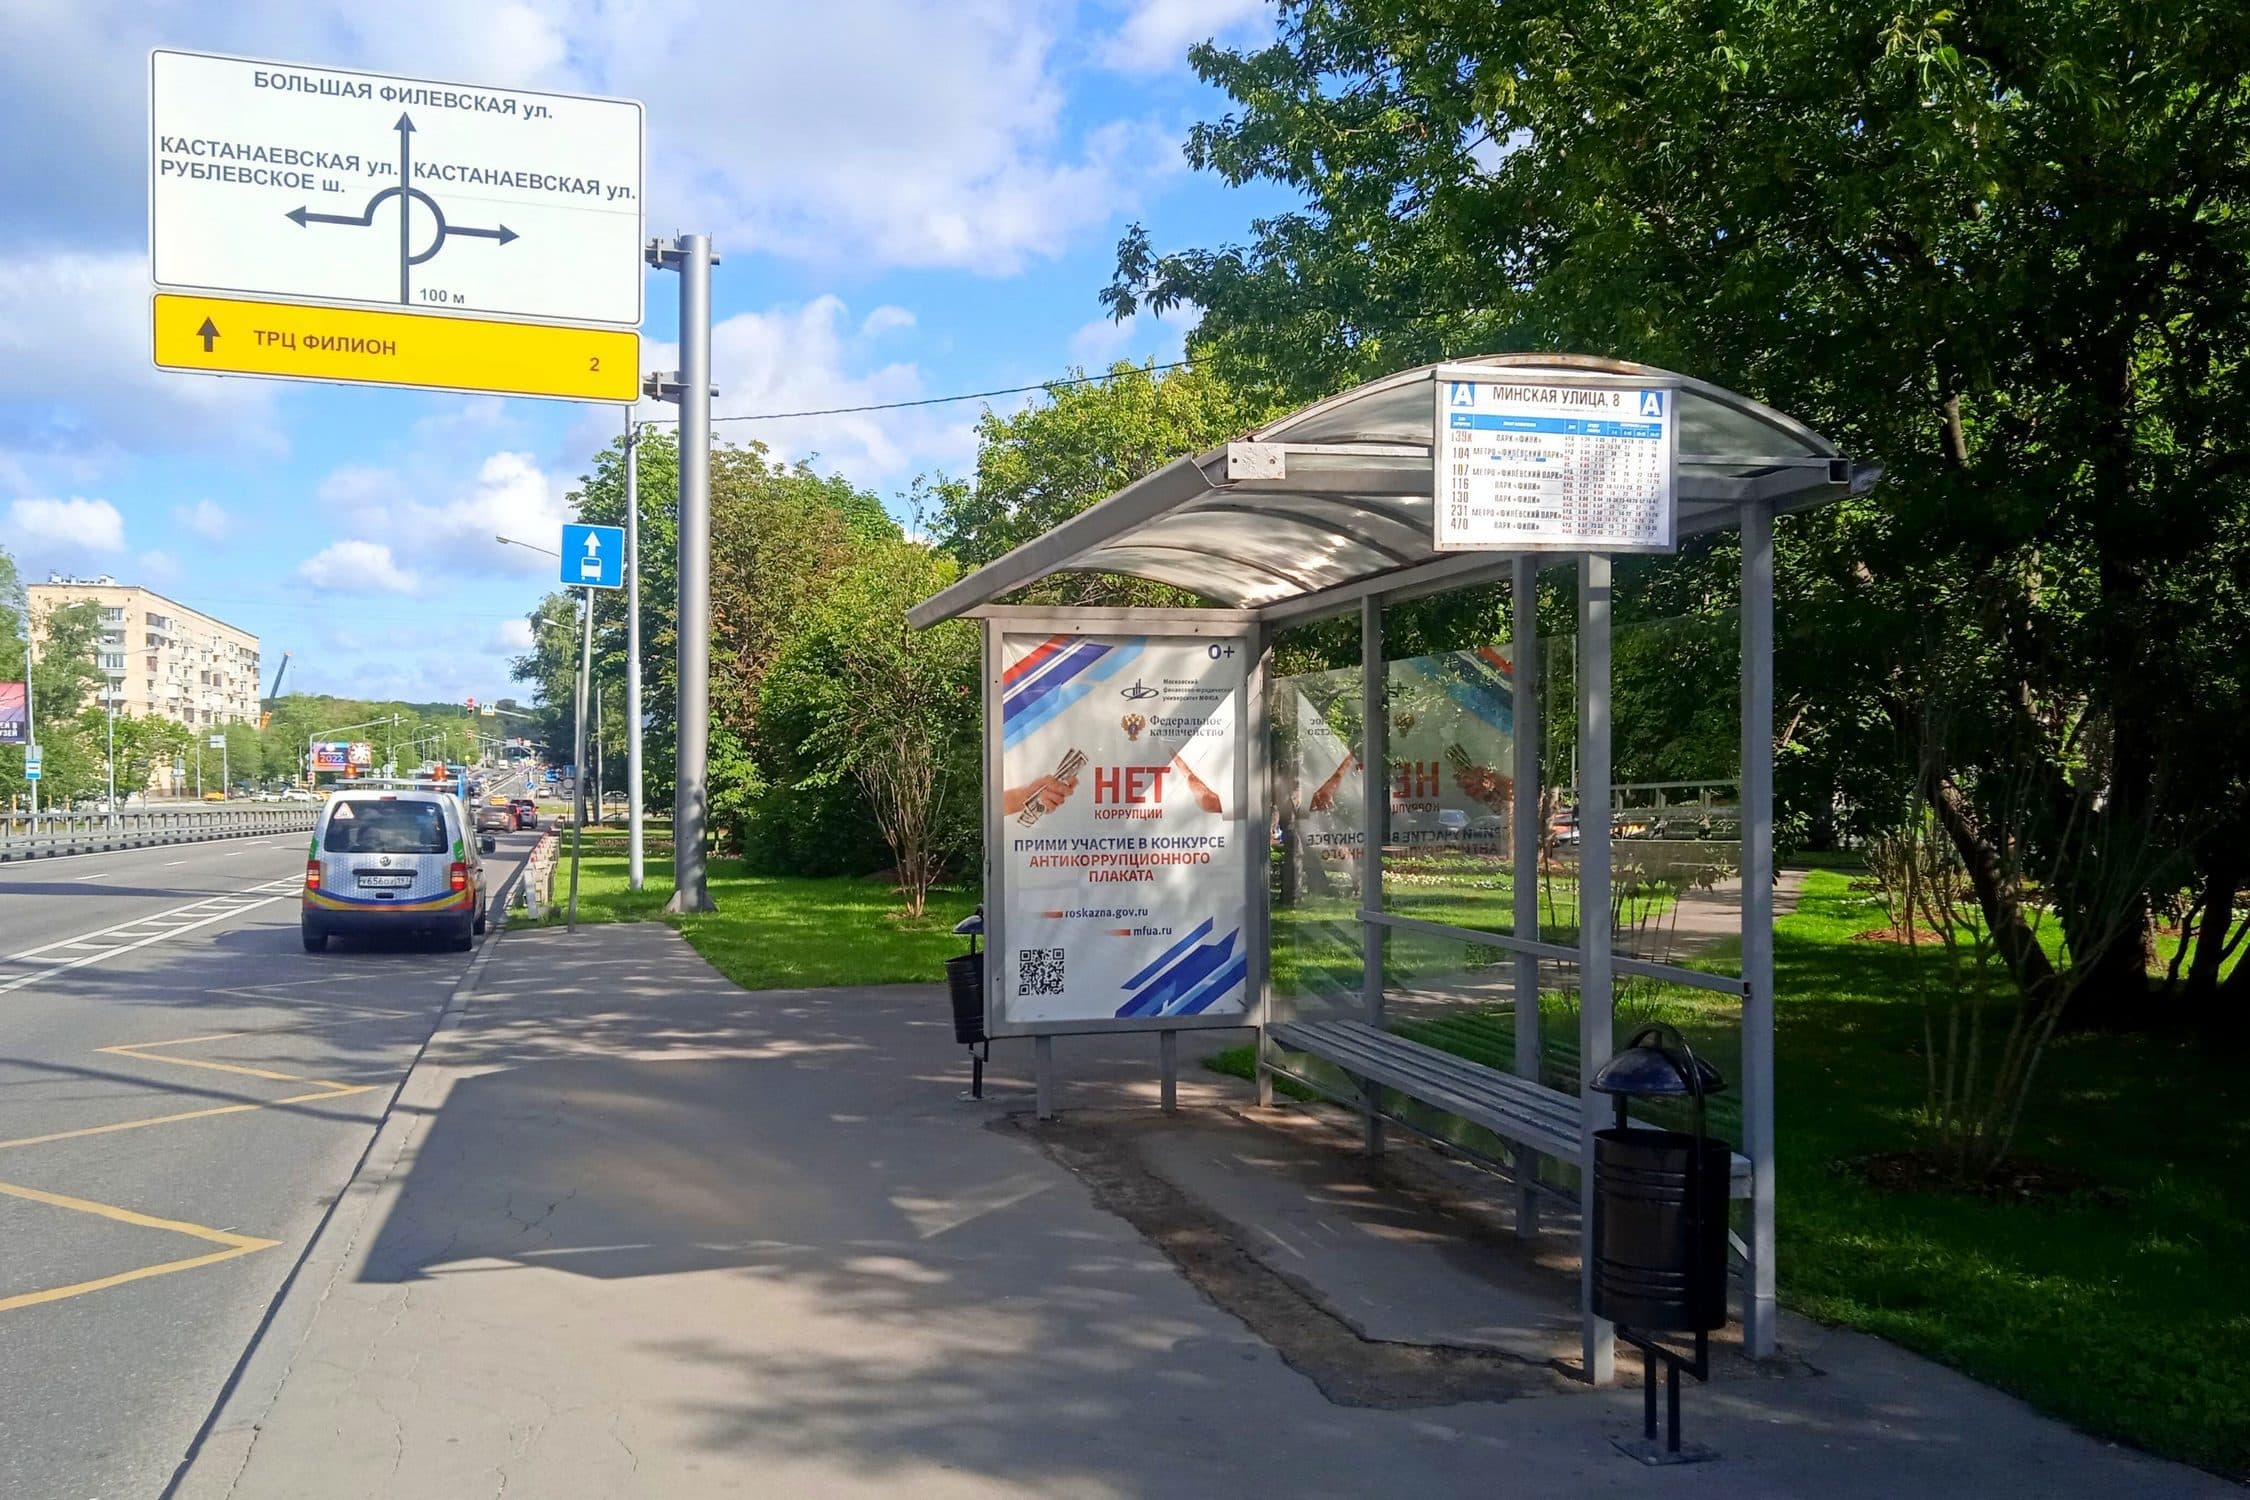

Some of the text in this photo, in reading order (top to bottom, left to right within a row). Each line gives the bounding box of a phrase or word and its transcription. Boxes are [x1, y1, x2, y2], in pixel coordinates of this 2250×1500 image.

[253, 70, 554, 121] БОЛЬШАЯ ФИЛЕВСКАЯ ул.
[159, 135, 399, 178] КАСТАНАЕВСКАЯ ул.
[159, 160, 346, 193] РУБЛЕВСКОЕ ш.
[412, 161, 637, 201] КАСТАНАЕВСКАЯ ул.
[419, 288, 465, 304] 100 м
[253, 330, 397, 356] ТРЦ ФИЛИОН
[589, 357, 601, 373] 2
[1493, 386, 1620, 408] МИНСКАЯ УЛИЦА, 8
[1453, 447, 1470, 460] 104
[1453, 463, 1469, 476] 107
[1452, 477, 1469, 490] 116
[1452, 491, 1469, 504] 130
[1451, 504, 1468, 517] 231
[1450, 518, 1468, 530] 470
[1207, 643, 1236, 660] 0+
[319, 755, 344, 763] 2022
[1094, 766, 1172, 805] НЕТ
[1094, 808, 1163, 822] КОРРУПЦИИ
[1014, 836, 1226, 852] ПРИМИ УЧАСТИЕ В КОНКУРСЕ
[1029, 852, 1211, 869] АНТИКОРРУПЦИОННОГО
[1088, 869, 1155, 883] ПЛАКАТА
[1065, 907, 1149, 920] roskazna.gov.ru
[1133, 925, 1173, 937] mfua.ru
